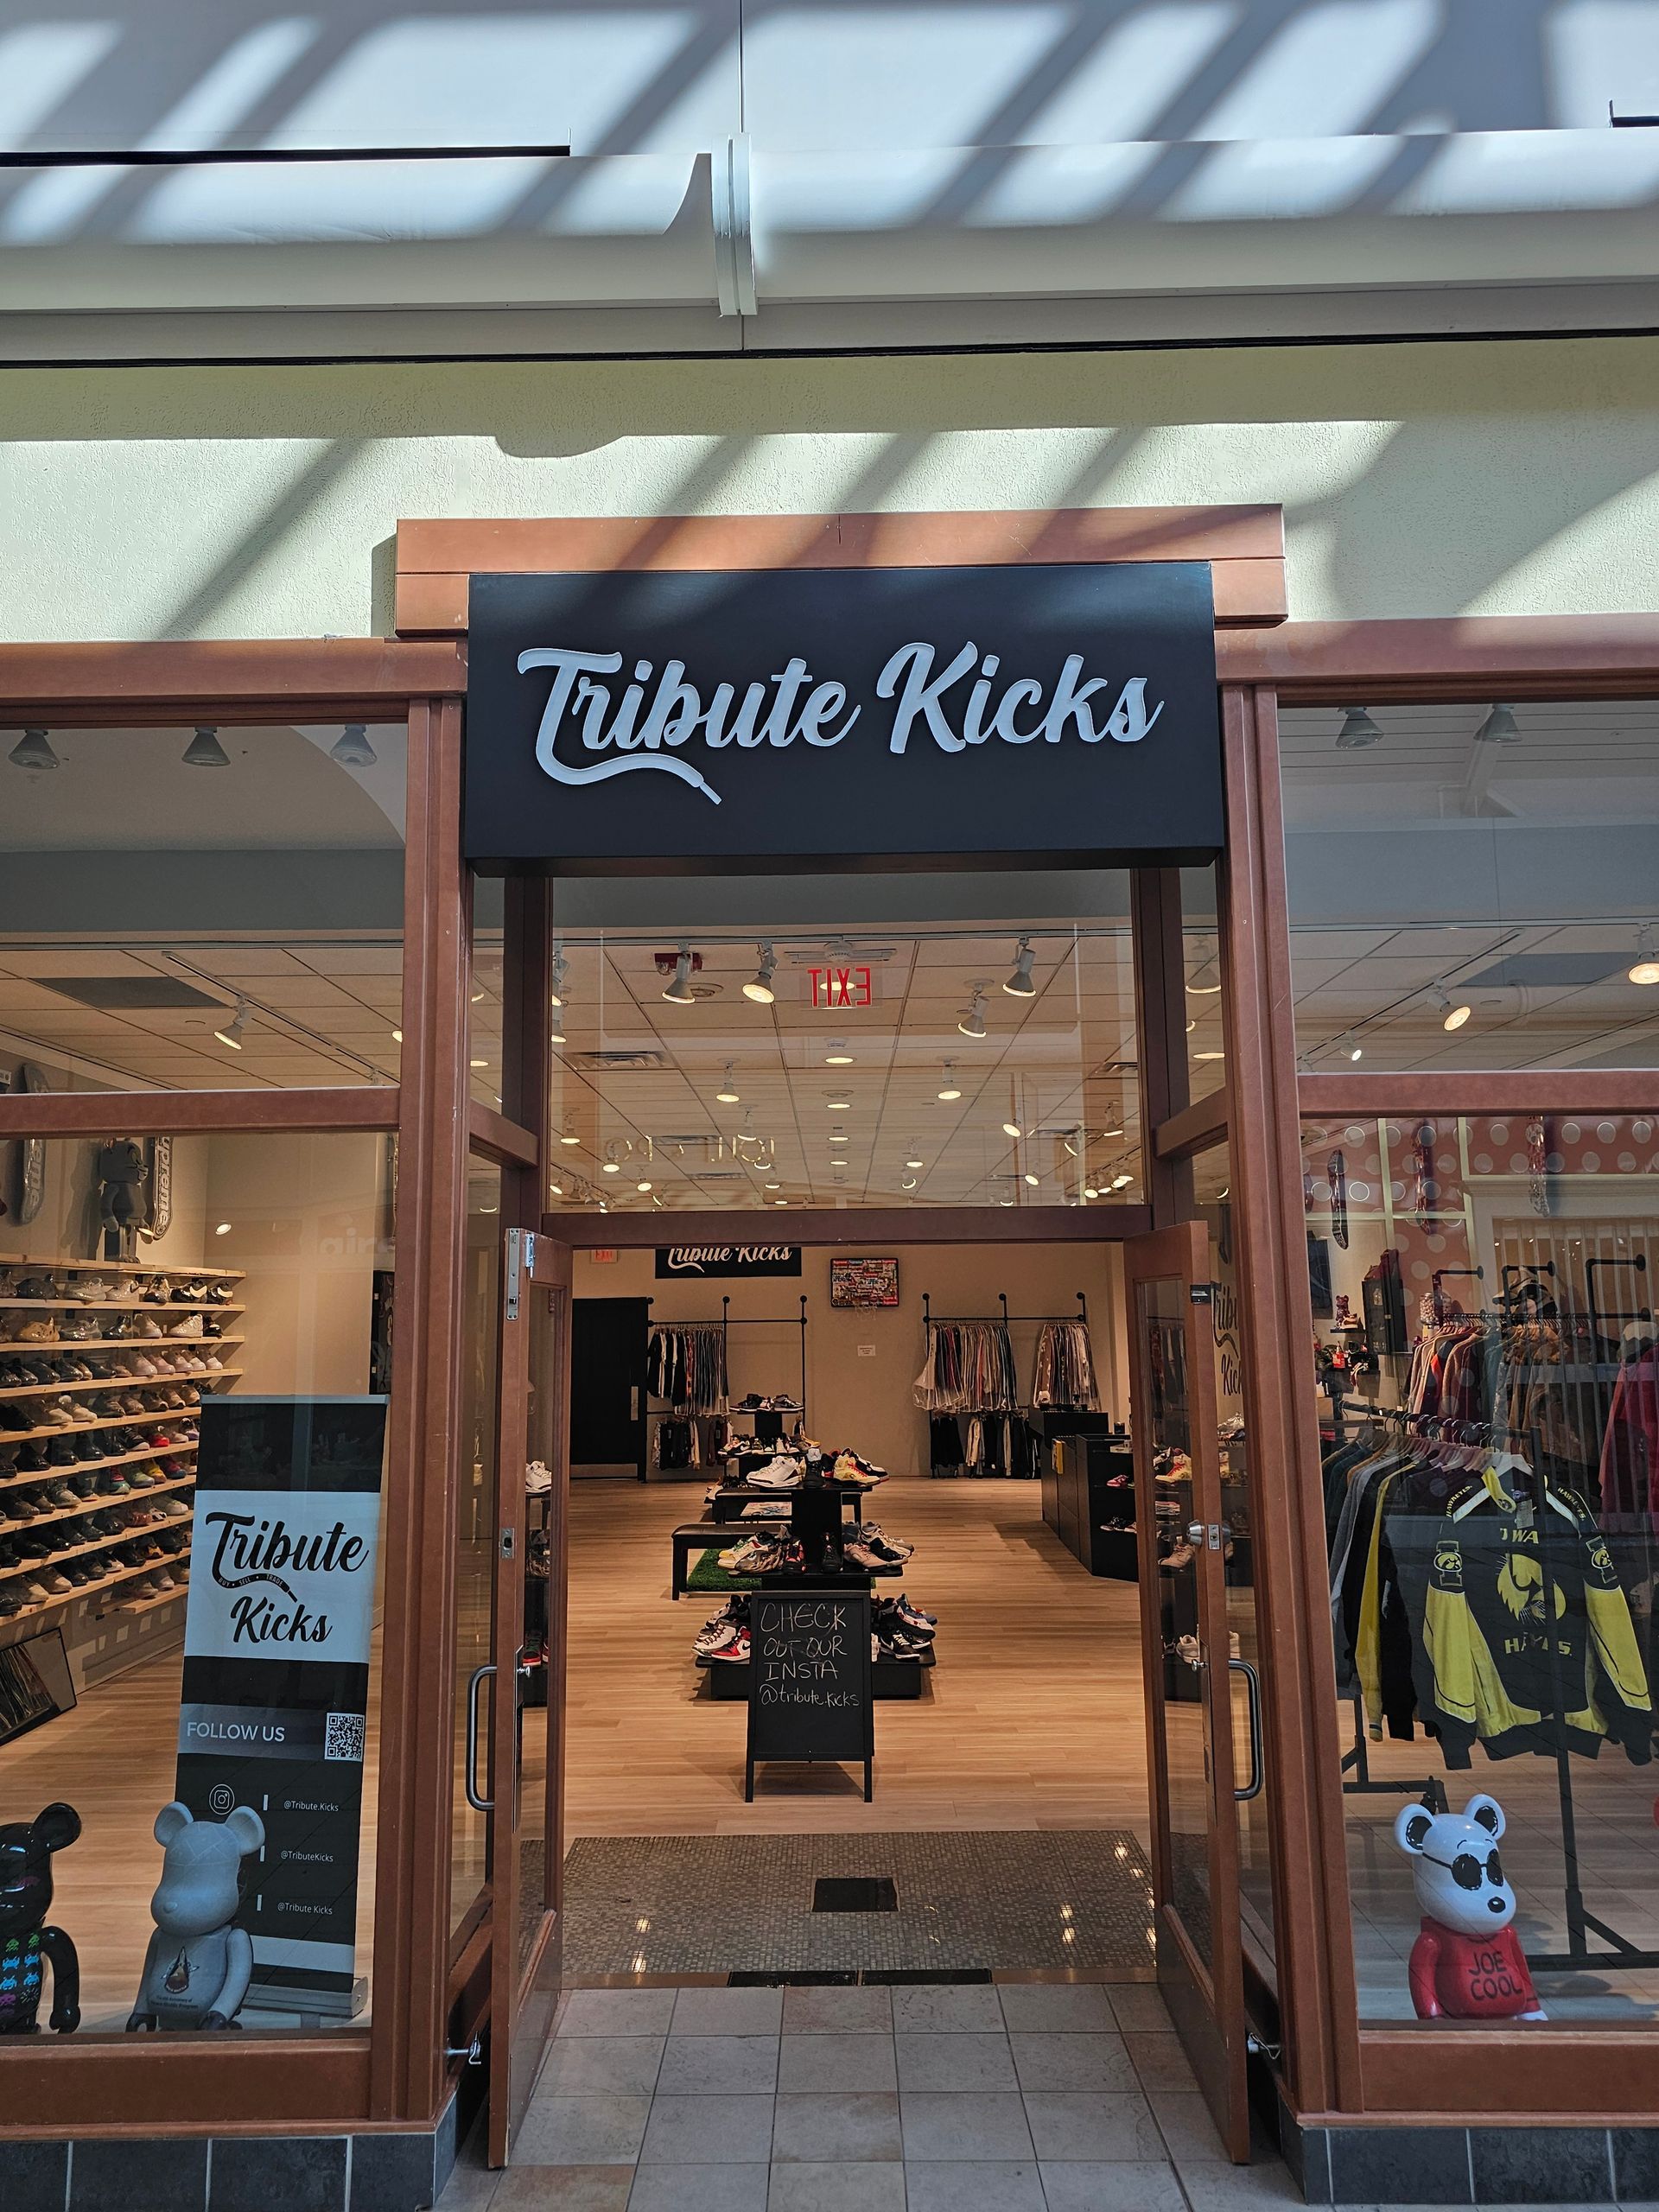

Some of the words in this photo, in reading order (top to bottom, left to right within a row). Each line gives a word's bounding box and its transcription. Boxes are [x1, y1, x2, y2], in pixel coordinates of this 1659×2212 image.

[517, 647, 861, 805] Tribute
[877, 641, 1165, 753] Kicks
[206, 1511, 369, 1603] Tribute
[218, 1577, 230, 1587] BUY
[238, 1576, 251, 1586] SELL
[266, 1573, 283, 1586] TRADE
[230, 1595, 333, 1643] Kicks
[760, 1602, 847, 1633] CHECK
[763, 1637, 801, 1658] OUT
[806, 1635, 848, 1658] OUR
[764, 1659, 838, 1681] INSTA
[187, 1721, 258, 1741] FOLLOW
[262, 1726, 285, 1742] US
[283, 1800, 339, 1812] @Tribute.Kicks
[280, 1850, 334, 1862] @TributeKicks
[277, 1902, 312, 1913] @Tribute
[314, 1905, 333, 1915] Kicks
[1468, 1951, 1508, 1976] JOE
[1471, 1975, 1523, 2001] COOL
